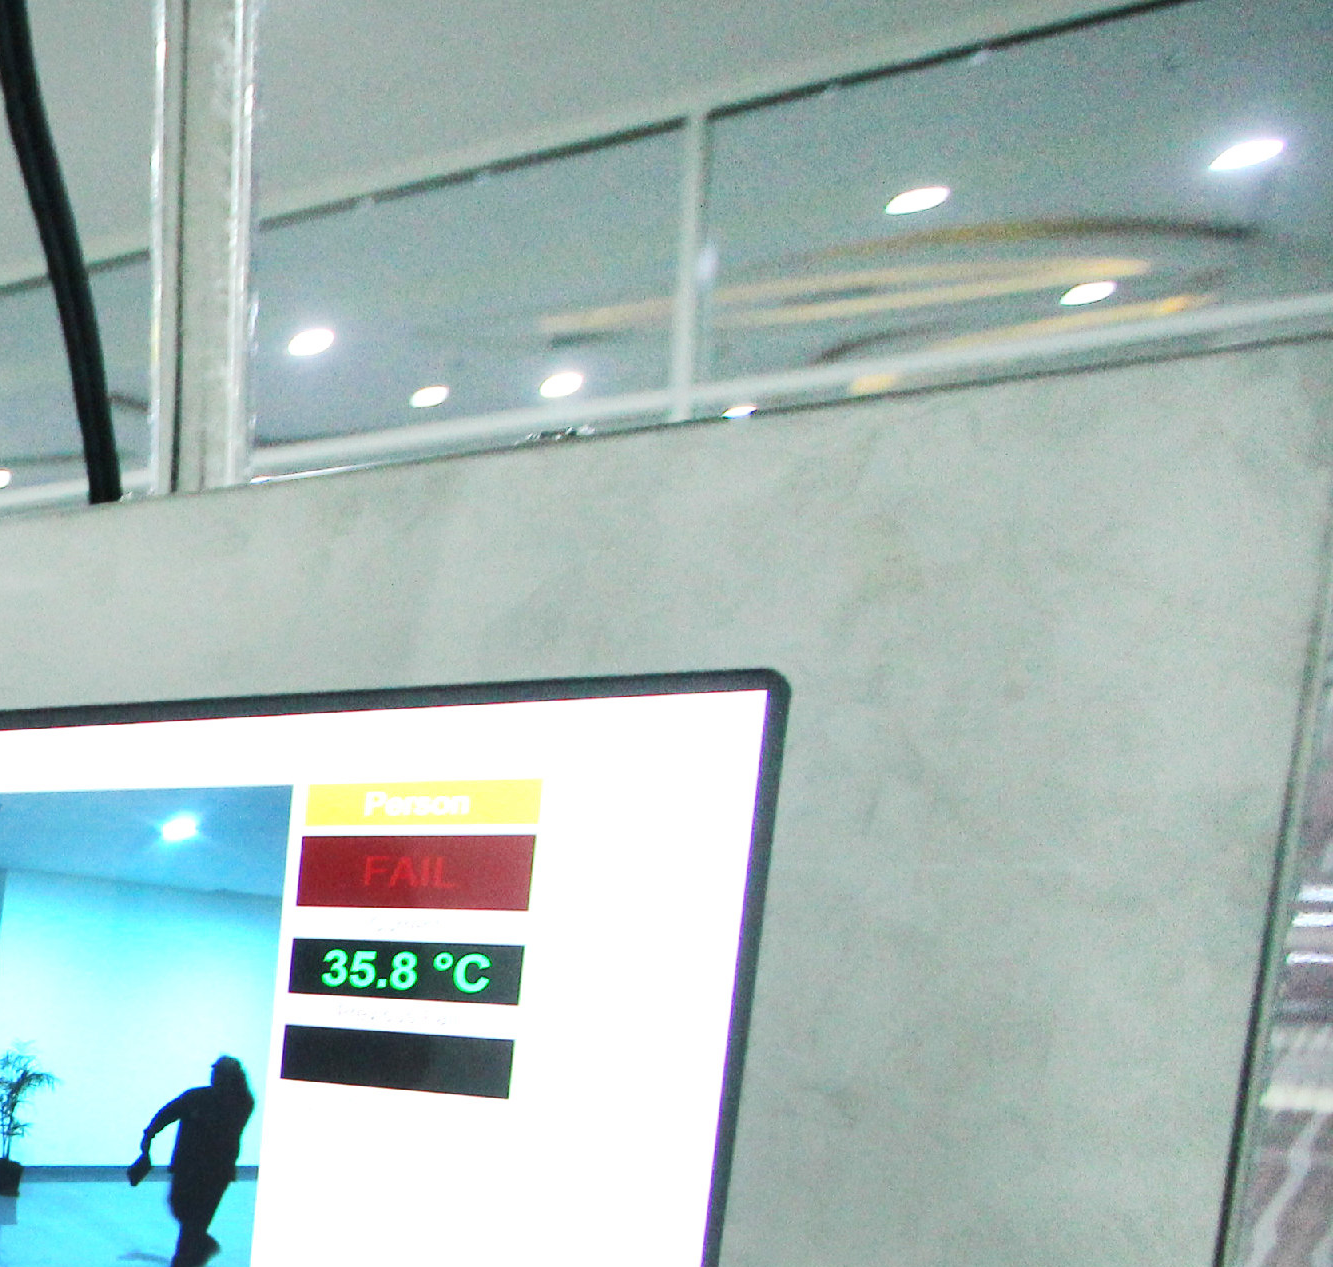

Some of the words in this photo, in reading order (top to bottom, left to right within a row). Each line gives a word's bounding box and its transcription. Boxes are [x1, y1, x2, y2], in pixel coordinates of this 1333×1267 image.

[364, 791, 471, 817] Person
[362, 855, 458, 889] FAIL
[321, 948, 418, 991] 35.8
[433, 951, 491, 993] °C
